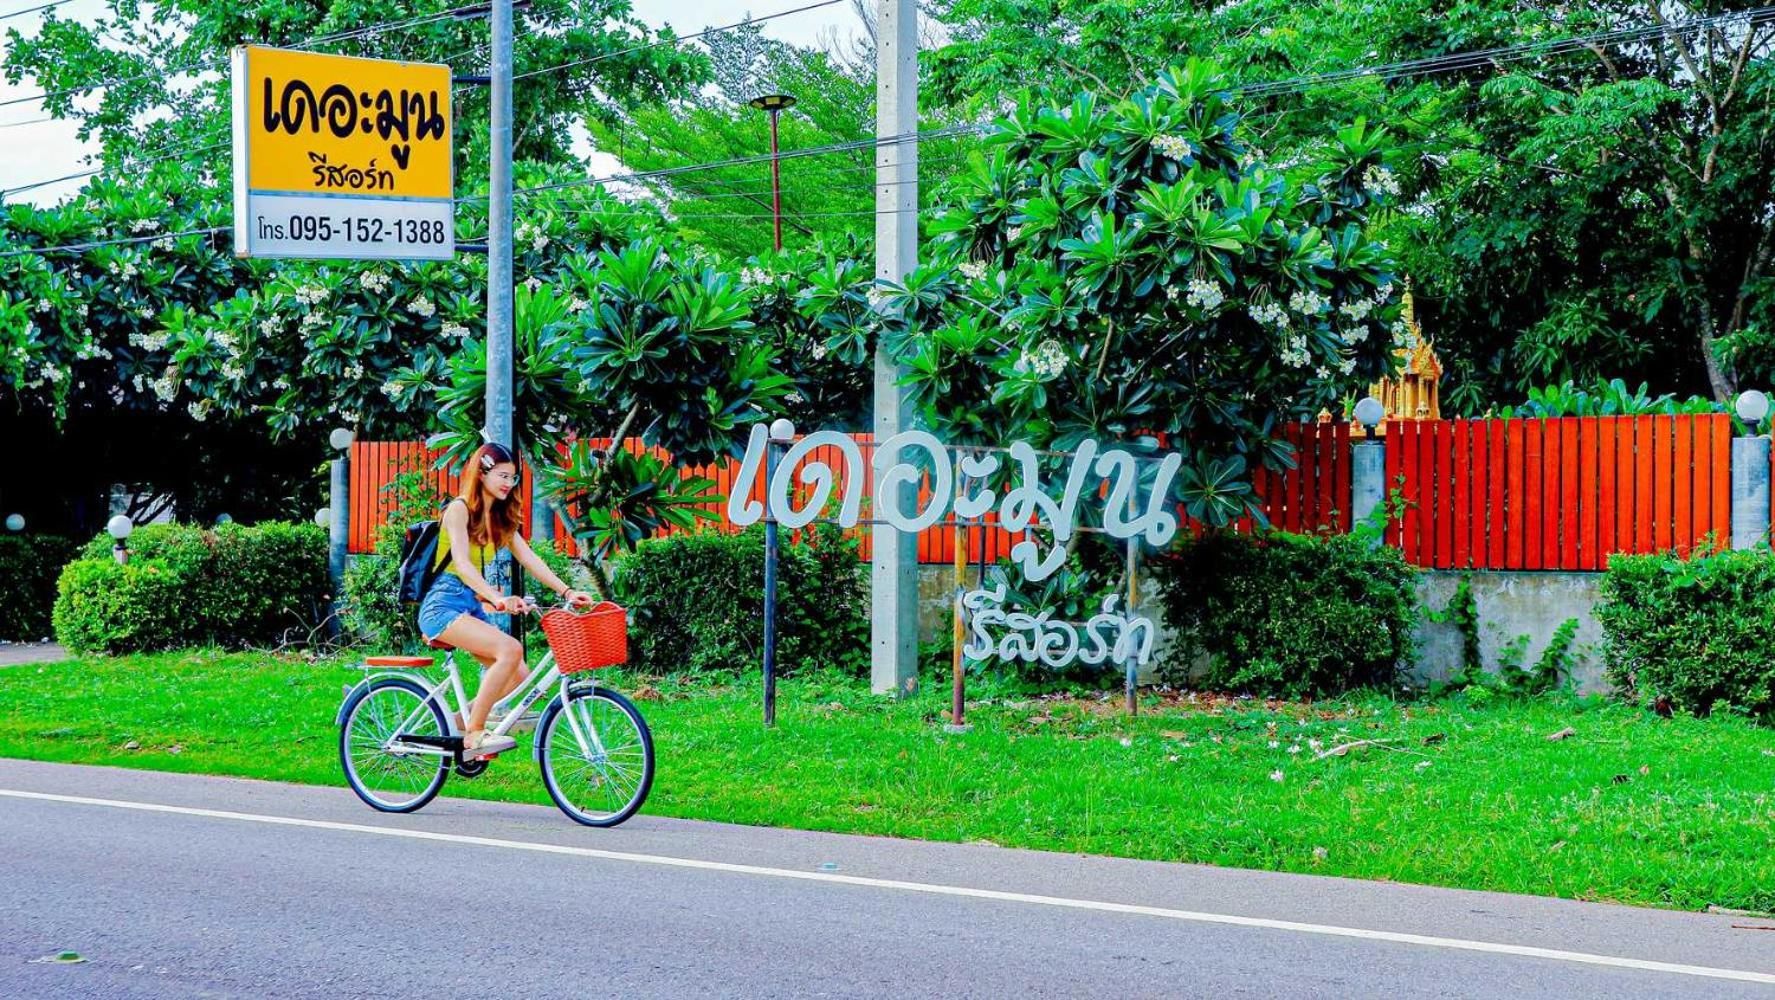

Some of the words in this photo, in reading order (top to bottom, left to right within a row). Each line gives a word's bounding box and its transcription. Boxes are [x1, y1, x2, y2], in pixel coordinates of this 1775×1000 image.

[263, 77, 445, 170] เดอะมูน
[308, 151, 394, 190] รีสอร์ท
[728, 423, 1182, 581] เดอะมูน
[963, 583, 1154, 667] รีสอร์ท
